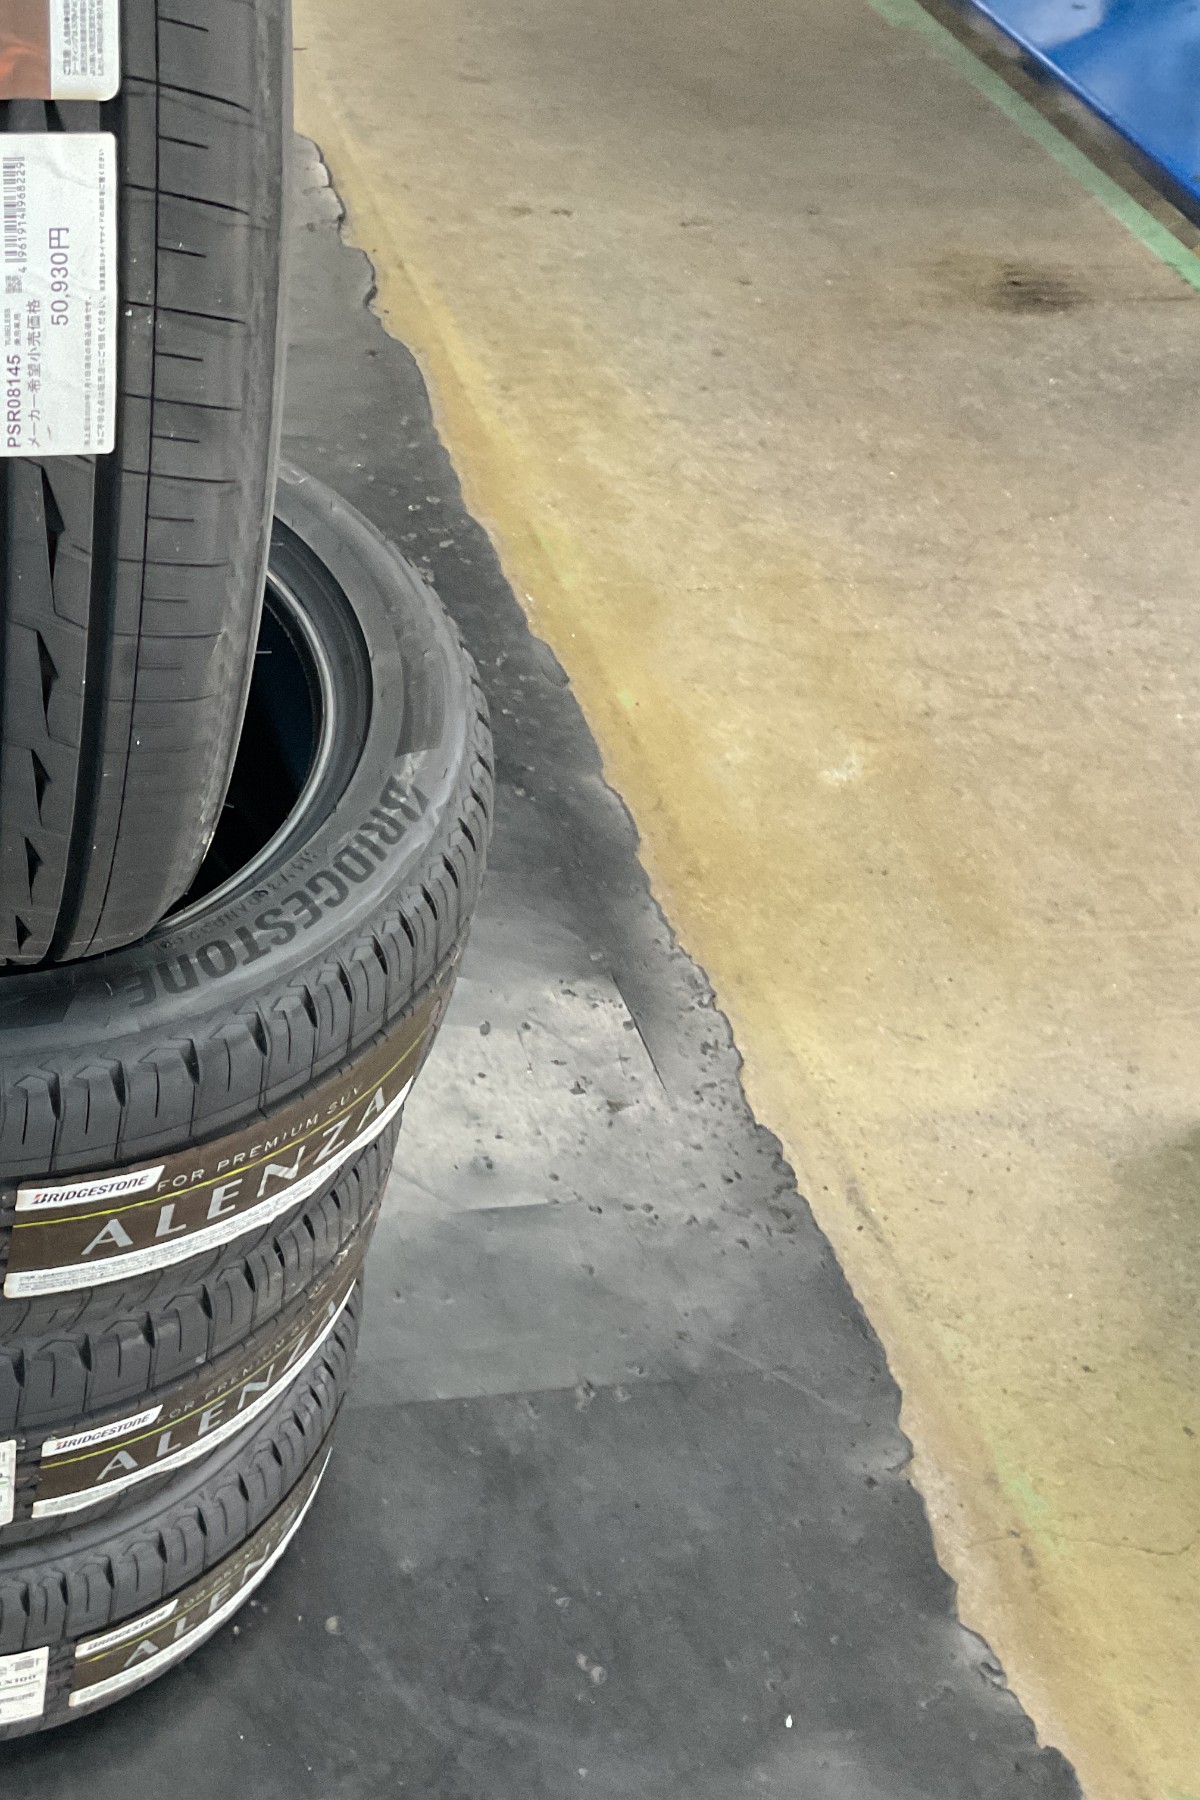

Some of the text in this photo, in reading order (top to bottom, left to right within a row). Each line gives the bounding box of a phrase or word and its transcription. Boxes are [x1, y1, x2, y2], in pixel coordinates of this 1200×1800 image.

[18, 266, 27, 274] 4
[48, 226, 71, 326] 50,930円
[6, 354, 22, 448] PSR08145
[26, 298, 42, 448] メーカー希望小売価格
[126, 776, 431, 1008] BRIDGESTONE
[31, 1174, 150, 1204] BRIDGESTONE
[80, 1086, 385, 1256] ALENZA
[156, 1168, 204, 1192] FOR
[216, 1114, 319, 1172] PREMIUM
[54, 1413, 150, 1450] BRIDGESTONE
[96, 1300, 336, 1481] ALENZA
